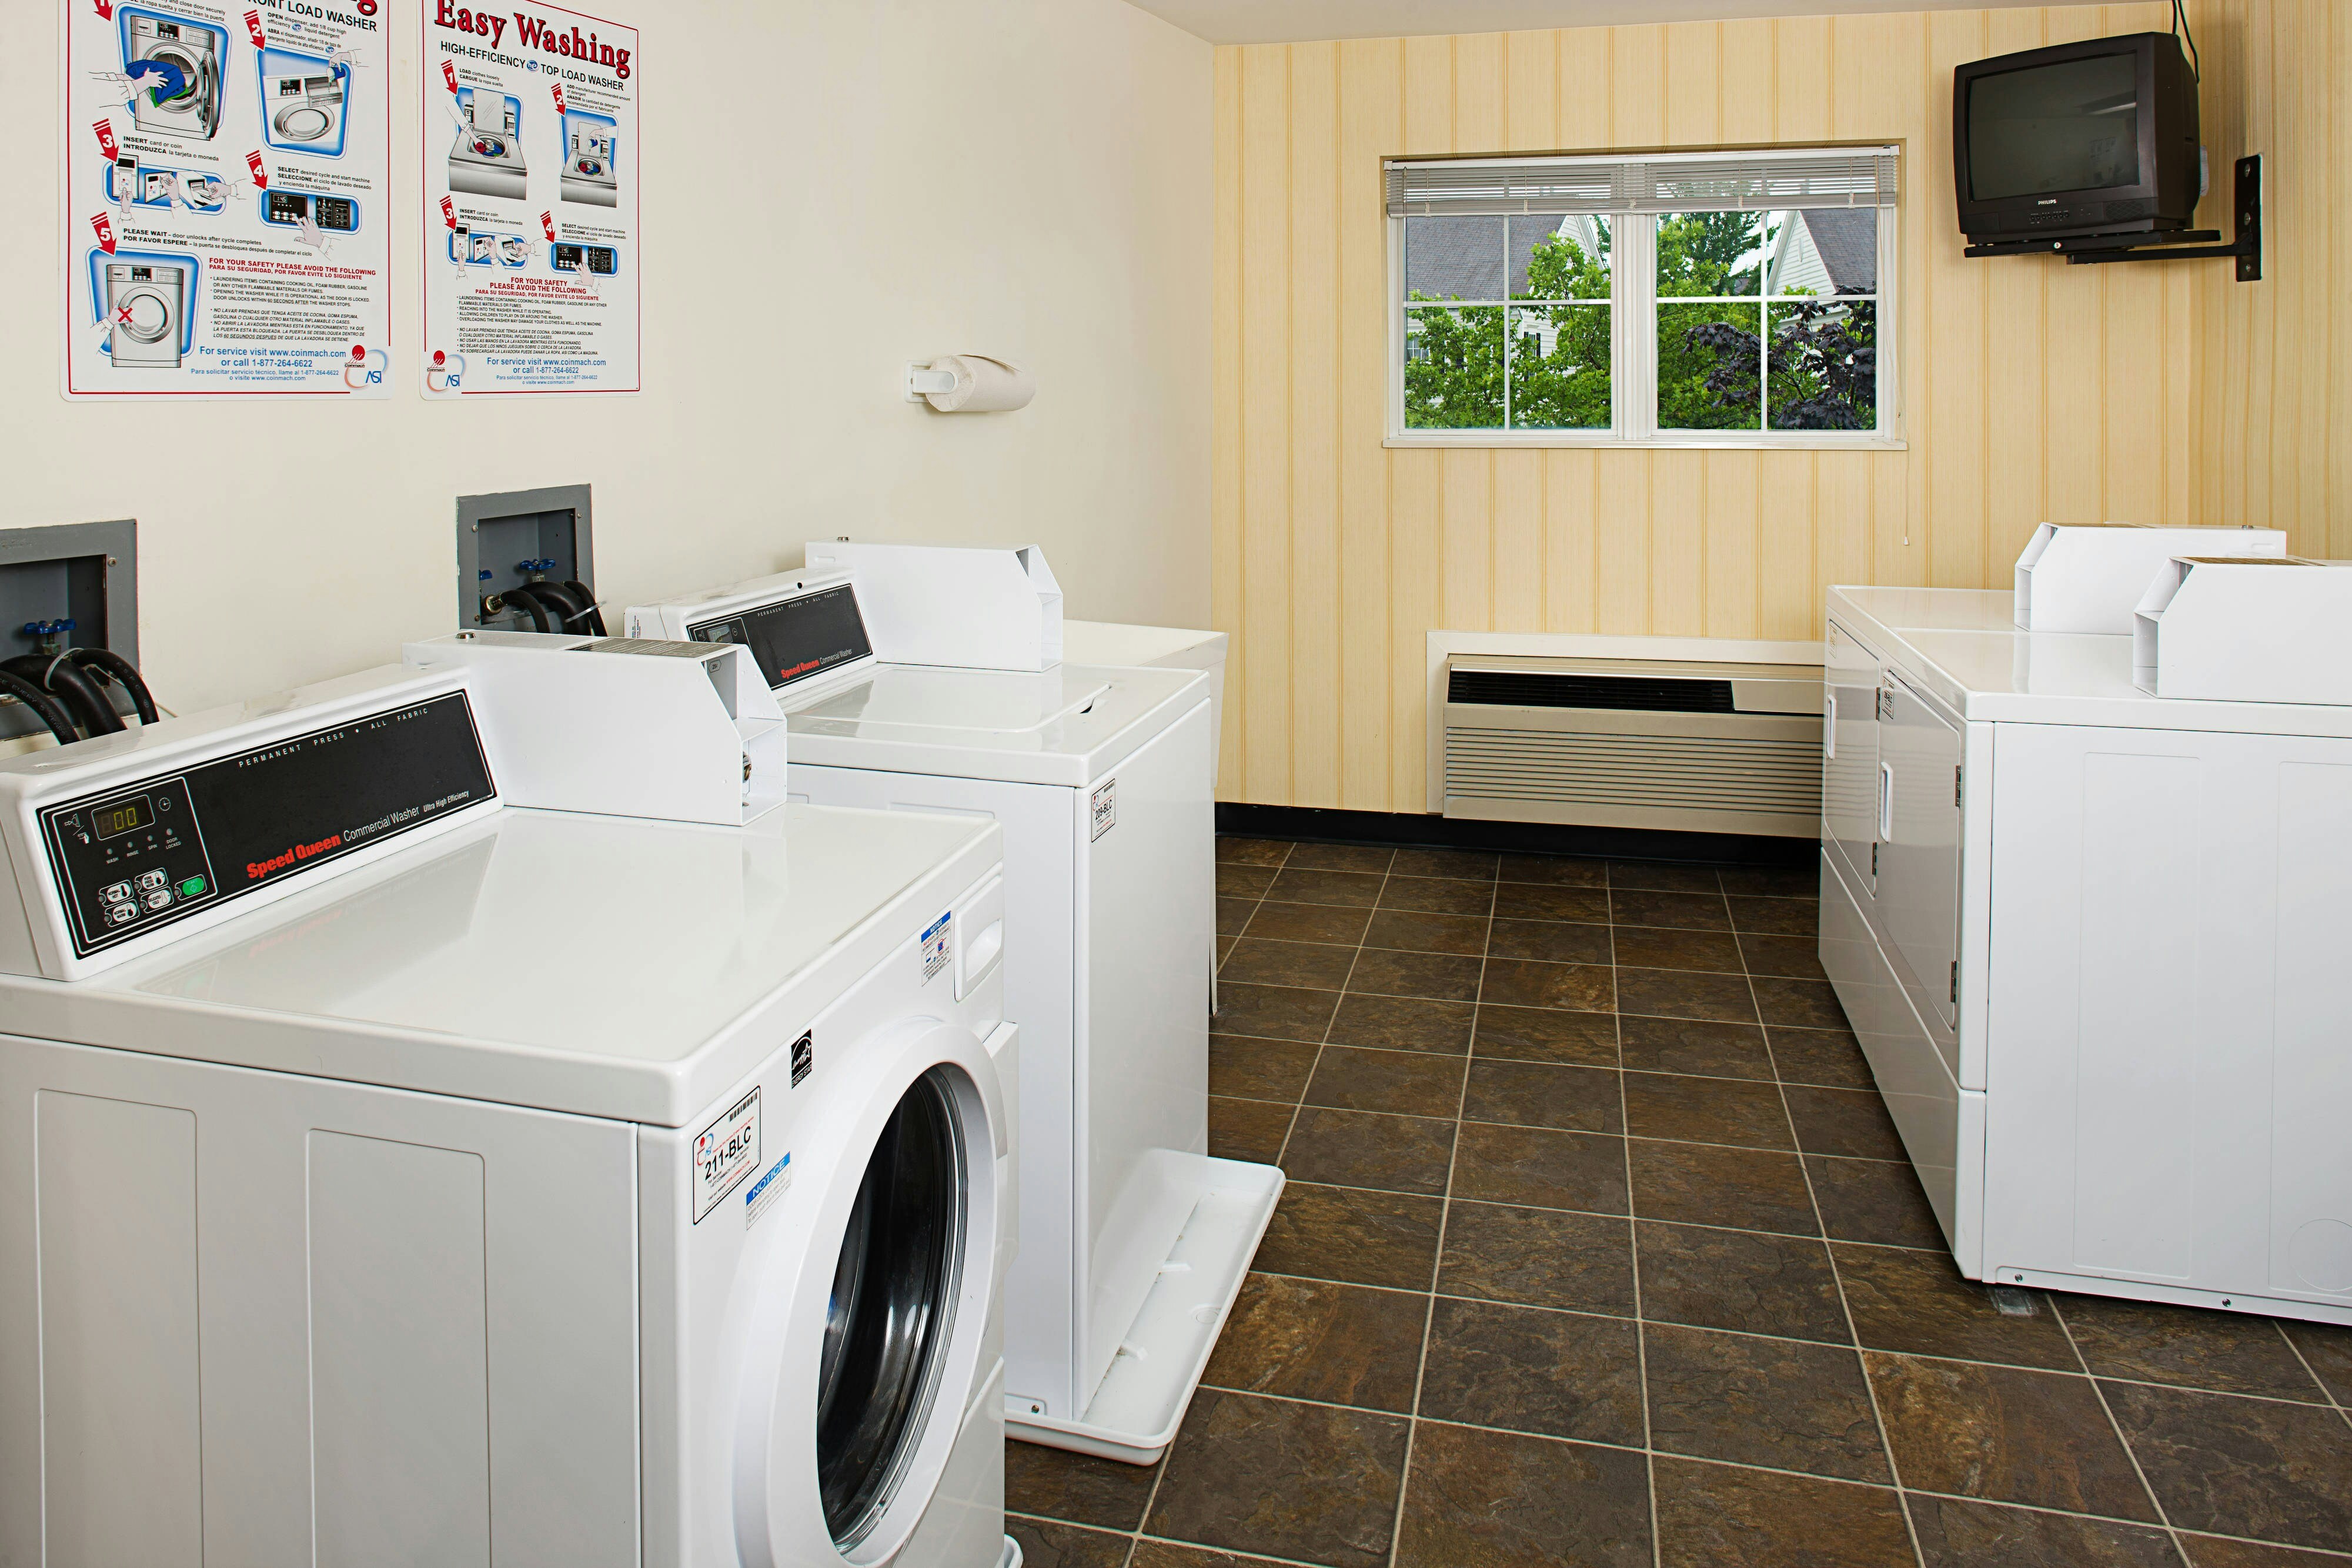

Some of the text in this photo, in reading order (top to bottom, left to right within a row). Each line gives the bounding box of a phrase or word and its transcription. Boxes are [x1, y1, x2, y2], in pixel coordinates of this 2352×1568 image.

[180, 1, 192, 9] close
[206, 6, 225, 15] securely
[288, 1, 323, 19] LOAD
[326, 10, 377, 32] WASHER
[251, 24, 260, 36] 2
[268, 19, 290, 28] efficiency
[319, 30, 340, 39] detergent
[434, 0, 630, 79] Easy Washing
[441, 41, 525, 68] HIGH-EFFICIENCY
[541, 63, 559, 76] TOP
[562, 69, 586, 82] LOAD
[588, 75, 624, 91] WASHER
[447, 72, 453, 83] 1
[556, 95, 563, 105] 2
[102, 134, 113, 148] 3
[123, 136, 148, 144] INSERT
[123, 143, 166, 154] INTRODUZCA
[254, 165, 263, 177] 4
[278, 173, 313, 182] SELECCIONE
[446, 208, 453, 219] 3
[546, 223, 552, 232] 4
[100, 228, 111, 241] 5
[200, 346, 215, 355] For
[269, 348, 347, 357] www.coinmach.com
[252, 359, 313, 367] 1-877-264-6622
[757, 606, 784, 617] PERMANENT
[781, 648, 853, 679] Speed Queen Commercial Washer
[239, 708, 428, 768] PERMANENT PRESS ALL FABRIC
[1095, 800, 1112, 820] 209-BLC
[246, 790, 469, 879] Speed Queen Commercial Washer Ultra High Efficiency
[165, 841, 182, 850] LOCKED
[930, 918, 943, 934] NOTICE
[791, 1071, 803, 1087] ENERGY
[705, 1125, 751, 1181] 211-BLC
[753, 1158, 785, 1198] NOTICE
